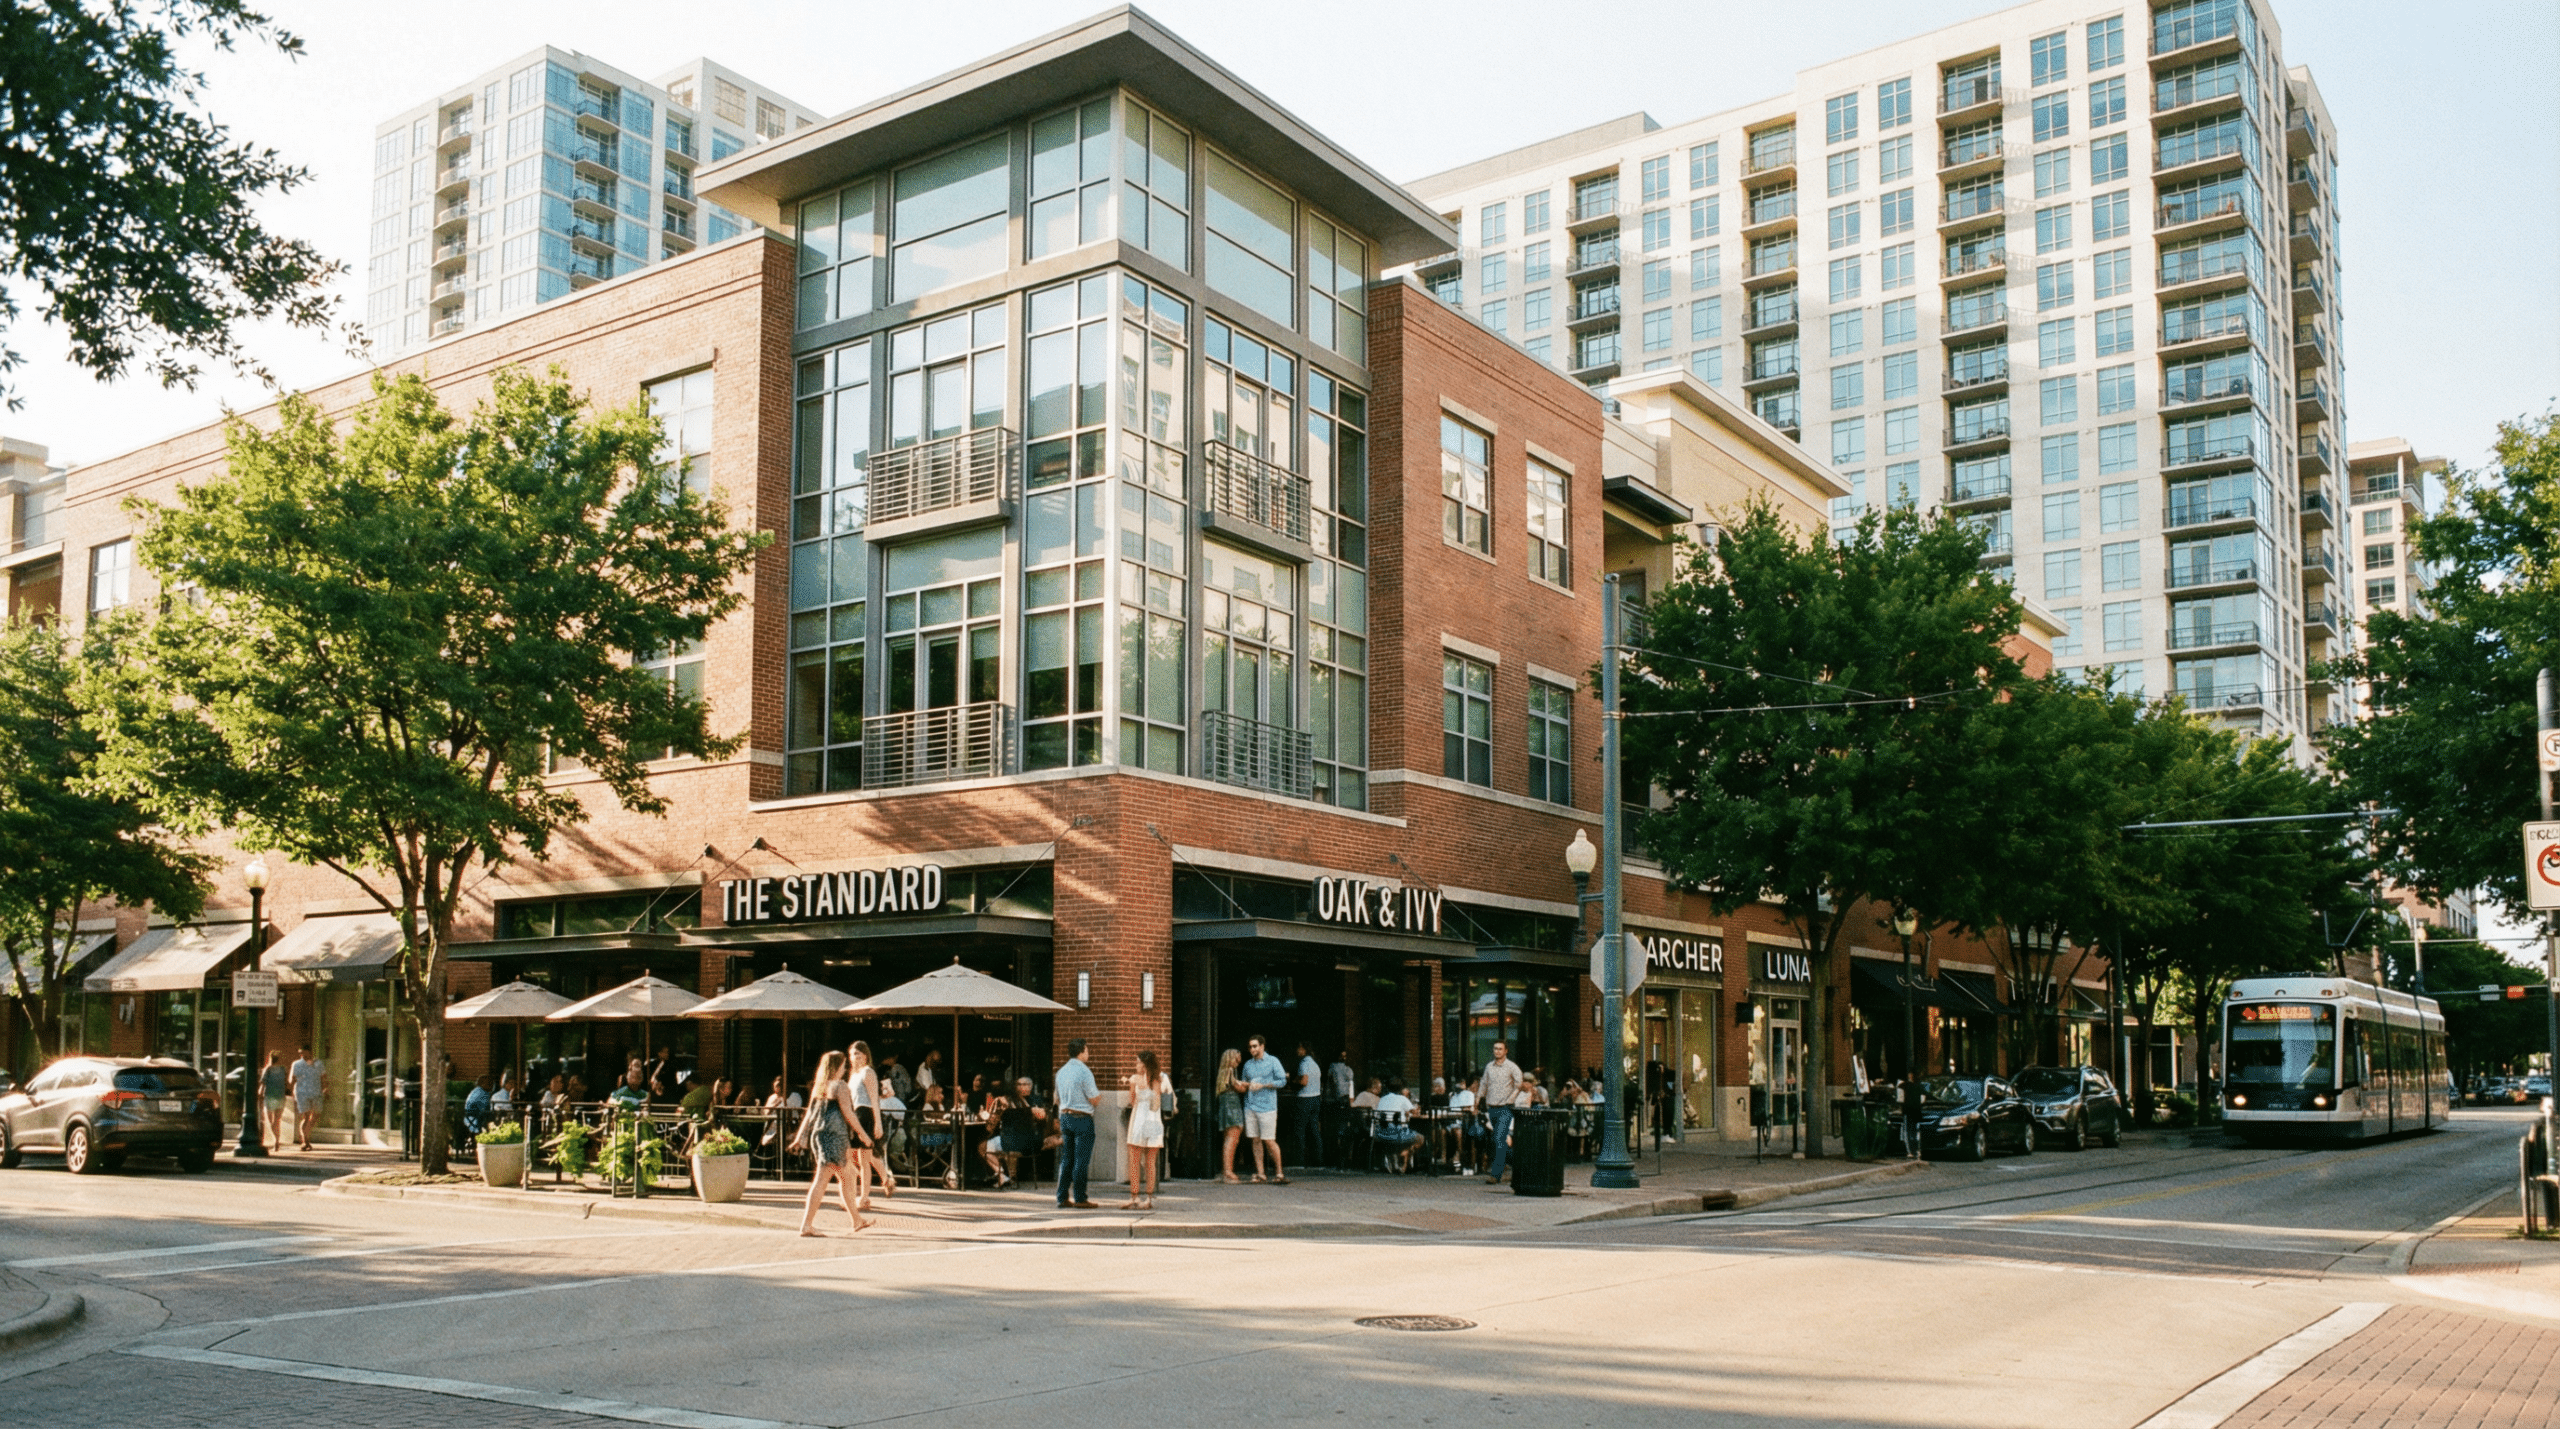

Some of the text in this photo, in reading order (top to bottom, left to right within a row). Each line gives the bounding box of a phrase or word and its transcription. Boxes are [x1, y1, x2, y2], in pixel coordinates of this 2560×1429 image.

[719, 864, 941, 922] THE STANDARD
[1319, 875, 1441, 933] OAK & IVY
[1646, 936, 1723, 973] ARCHER
[1767, 951, 1812, 983] LUNA
